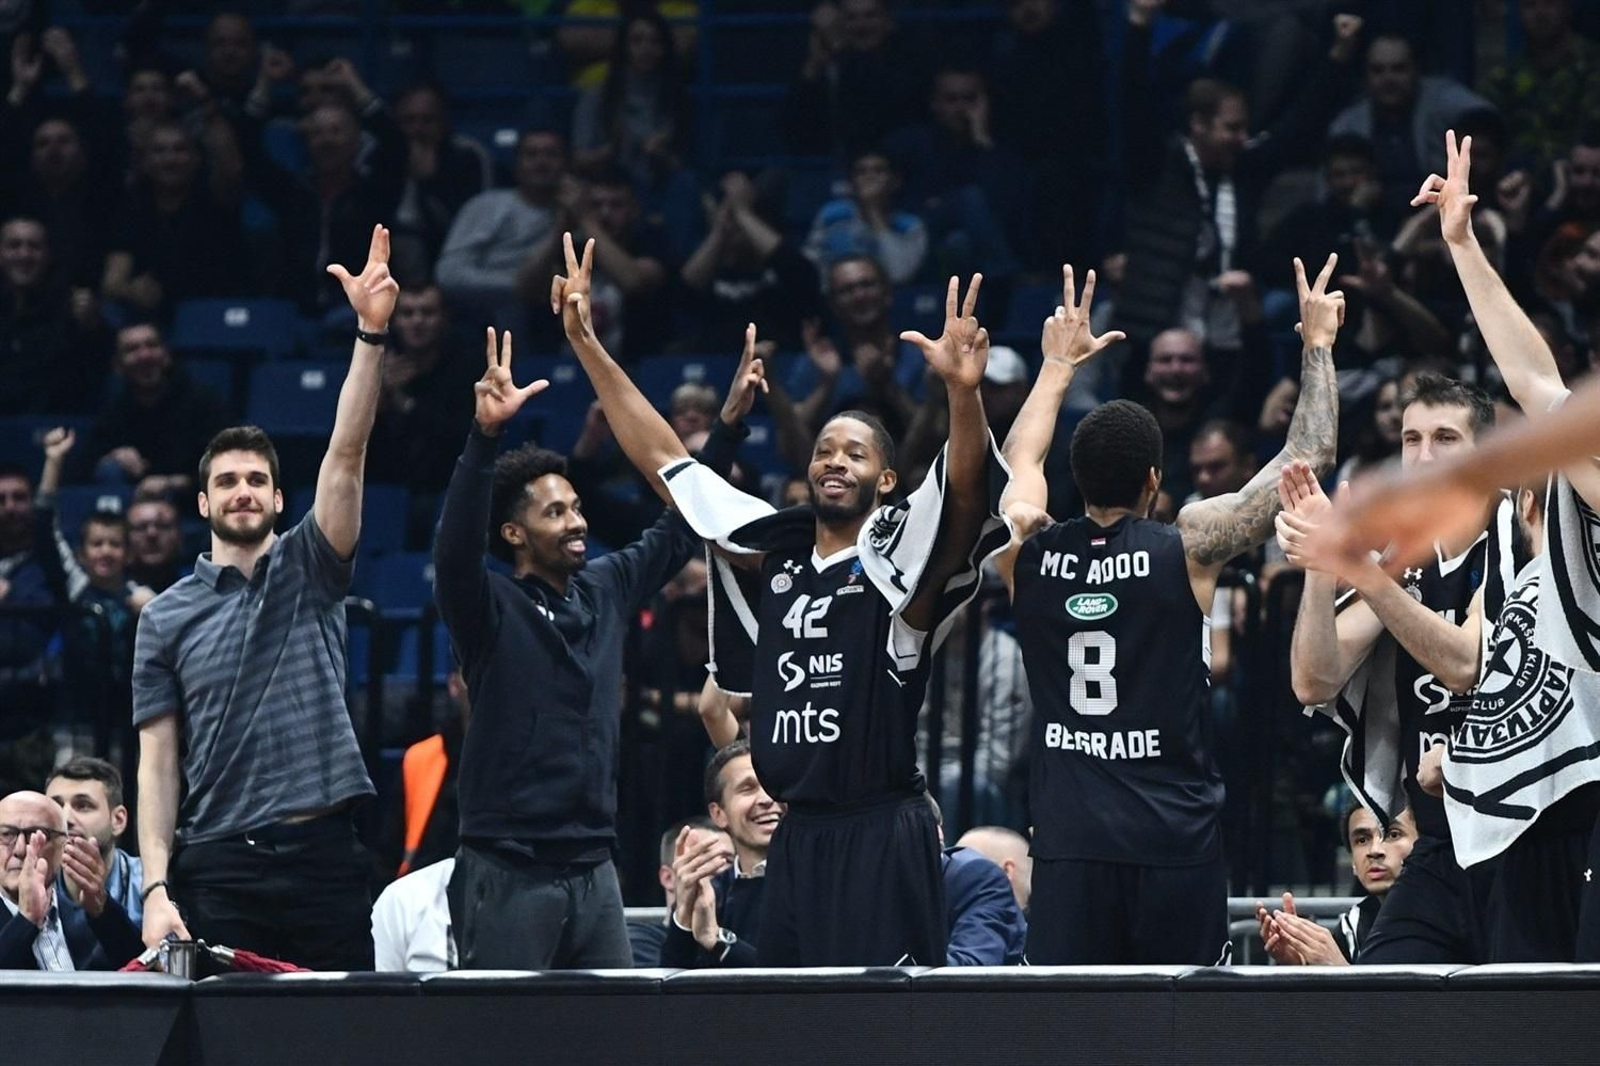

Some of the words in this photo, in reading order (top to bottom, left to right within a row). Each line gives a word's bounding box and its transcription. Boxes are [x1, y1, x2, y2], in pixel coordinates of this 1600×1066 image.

[1041, 550, 1079, 580] MC
[1085, 550, 1150, 585] ADOO
[781, 594, 833, 639] 42
[1077, 597, 1102, 606] LAND
[1078, 604, 1108, 614] ROVER
[809, 653, 843, 674] NIS
[1068, 630, 1118, 716] 8
[1516, 653, 1537, 688] KLUB
[1472, 698, 1505, 710] CLUB
[772, 701, 841, 744] mts
